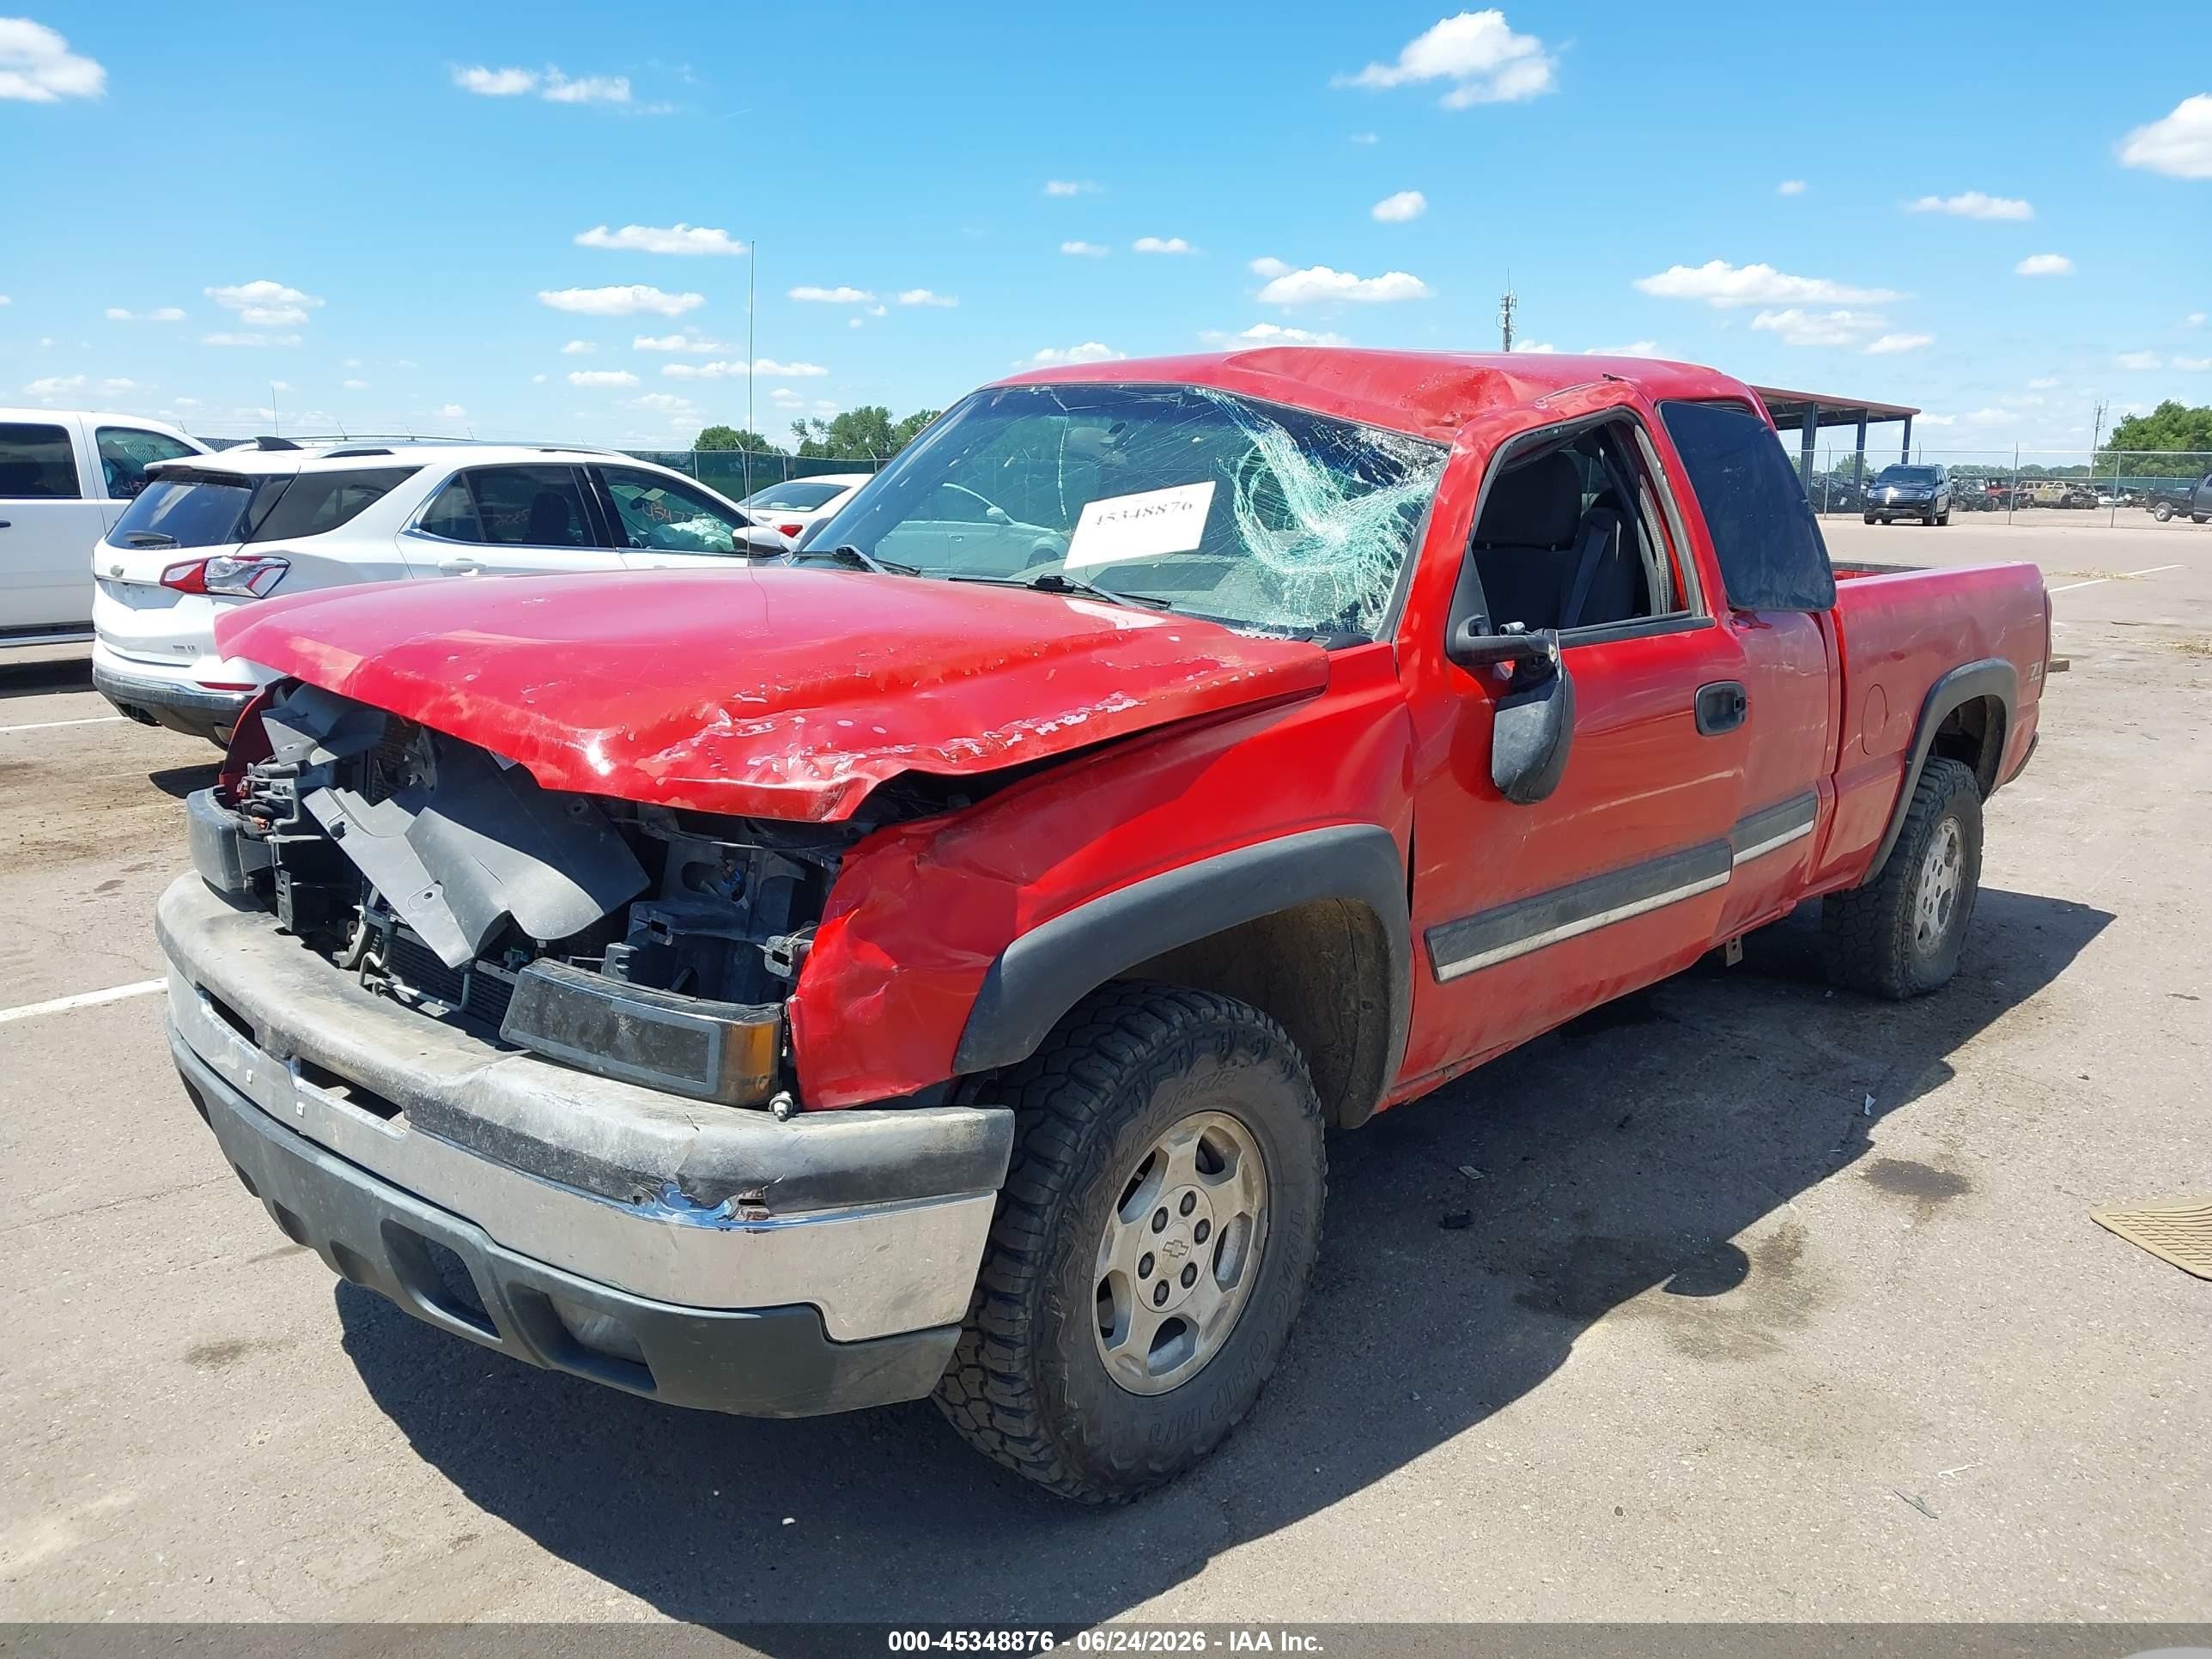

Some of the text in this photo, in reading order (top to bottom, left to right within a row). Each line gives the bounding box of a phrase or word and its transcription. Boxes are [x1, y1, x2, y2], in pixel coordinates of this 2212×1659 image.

[1094, 501, 1194, 526] 45348876
[1267, 1207, 1307, 1320] TRAC
[1209, 1330, 1270, 1422] GRIP
